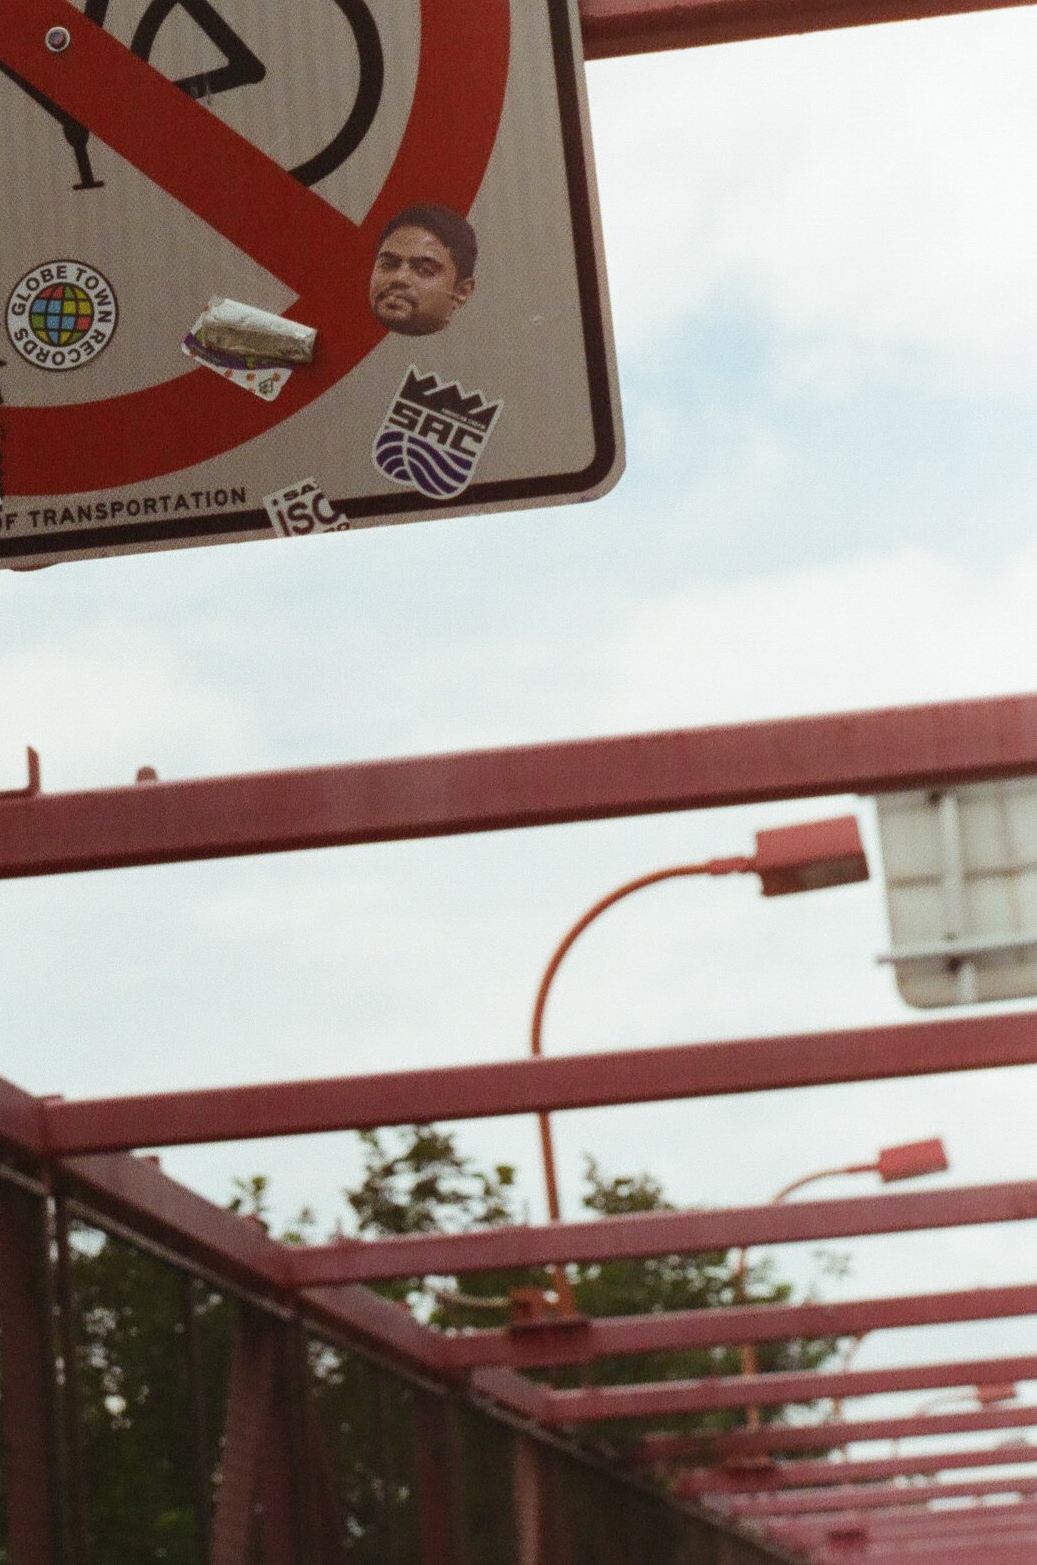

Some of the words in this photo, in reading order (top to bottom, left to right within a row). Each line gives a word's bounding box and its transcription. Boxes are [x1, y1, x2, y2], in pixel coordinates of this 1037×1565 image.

[11, 265, 68, 316] GLOBE
[75, 267, 113, 323] TOWN
[14, 328, 107, 366] RECORDS
[388, 400, 484, 458] SAC
[27, 486, 247, 528] TRANSPORTATION
